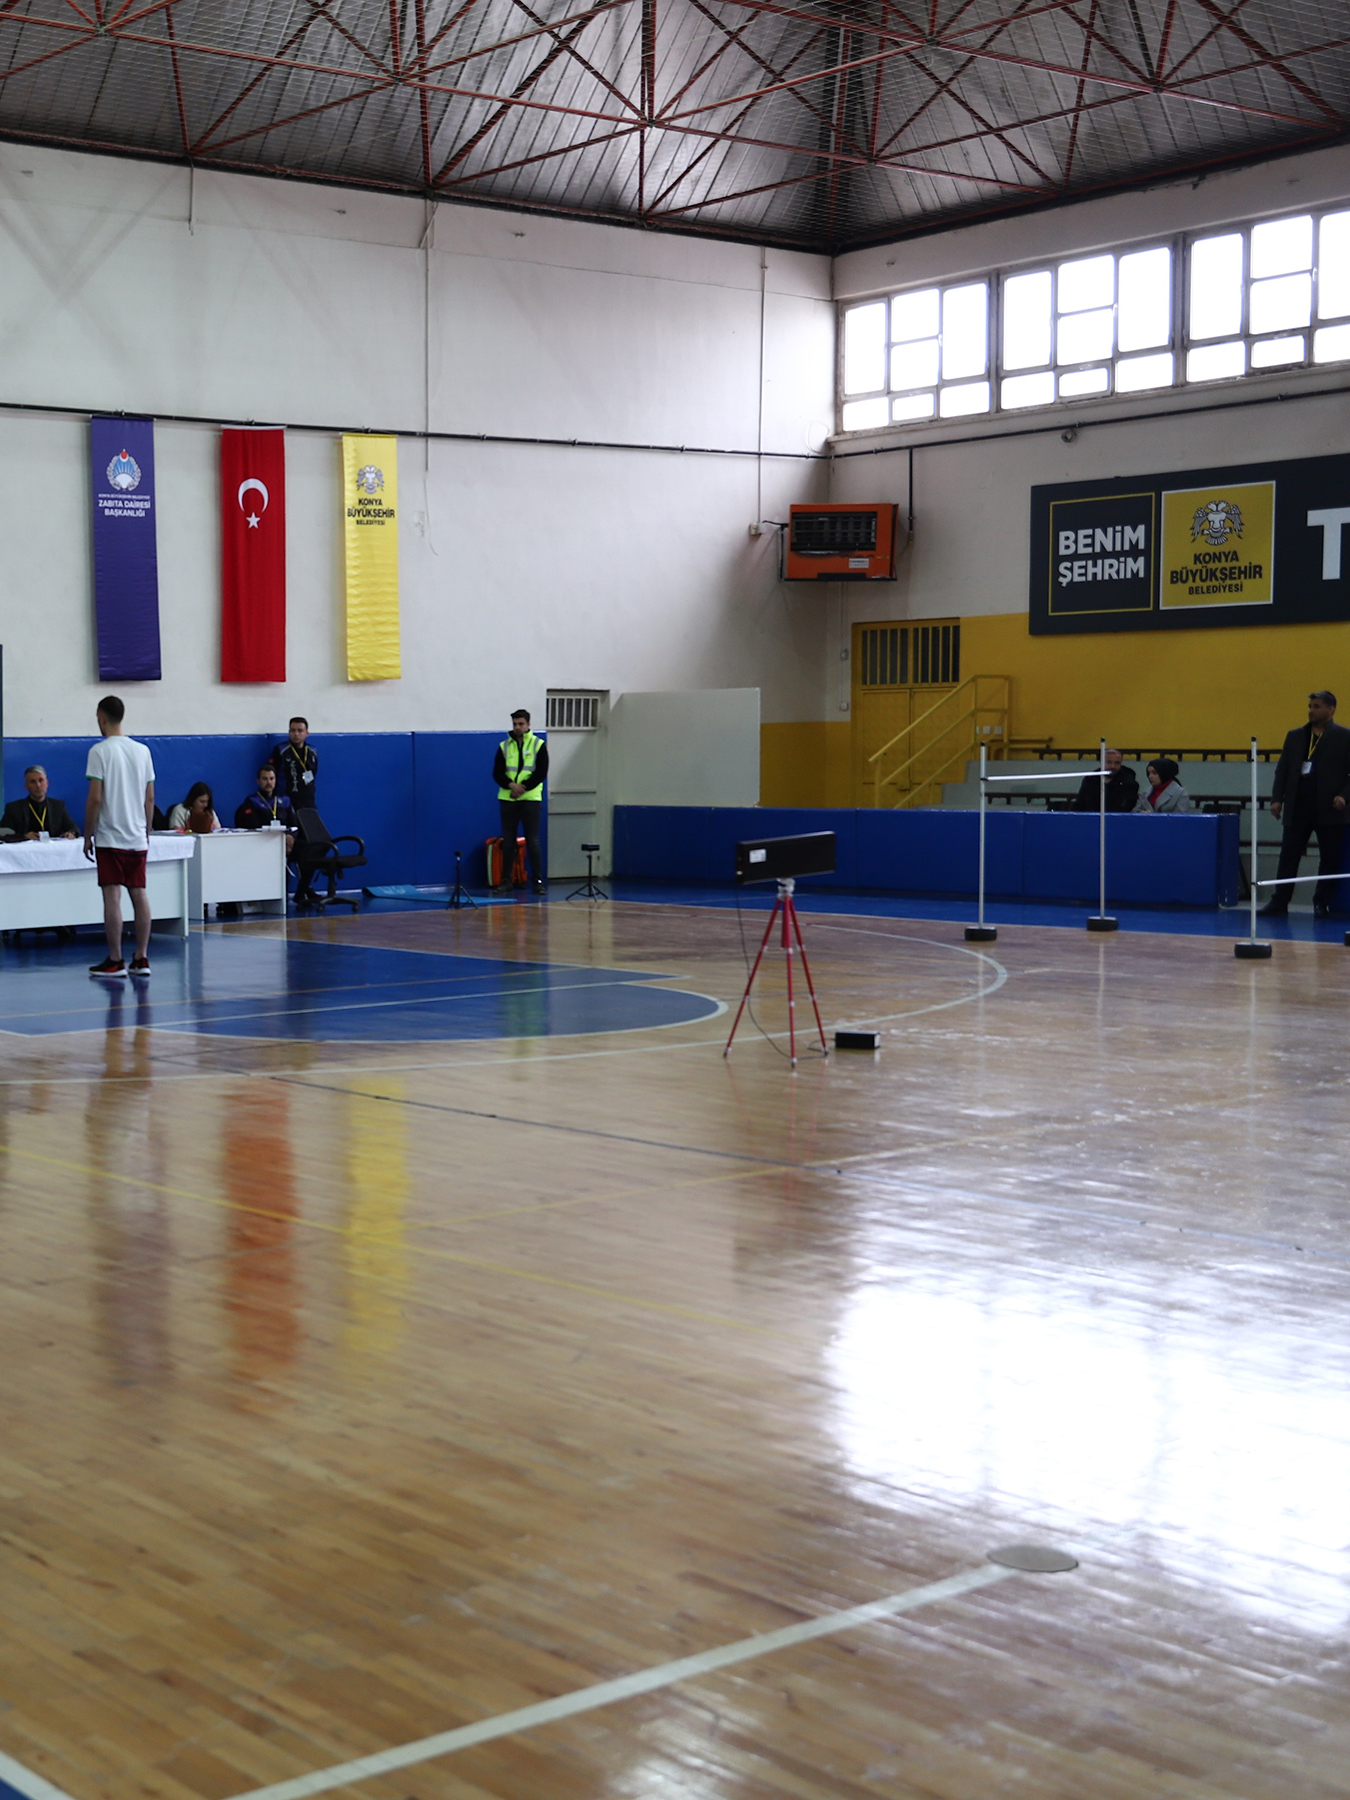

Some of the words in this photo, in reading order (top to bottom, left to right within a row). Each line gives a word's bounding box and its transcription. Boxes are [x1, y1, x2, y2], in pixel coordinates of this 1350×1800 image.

[358, 498, 383, 506] KONYA
[347, 506, 395, 518] BÜYÜKŞEHİR
[1193, 550, 1240, 565] KONYA
[1170, 562, 1263, 584] BÜYÜKŞEHİR
[1188, 581, 1243, 595] BELEDİYESİ
